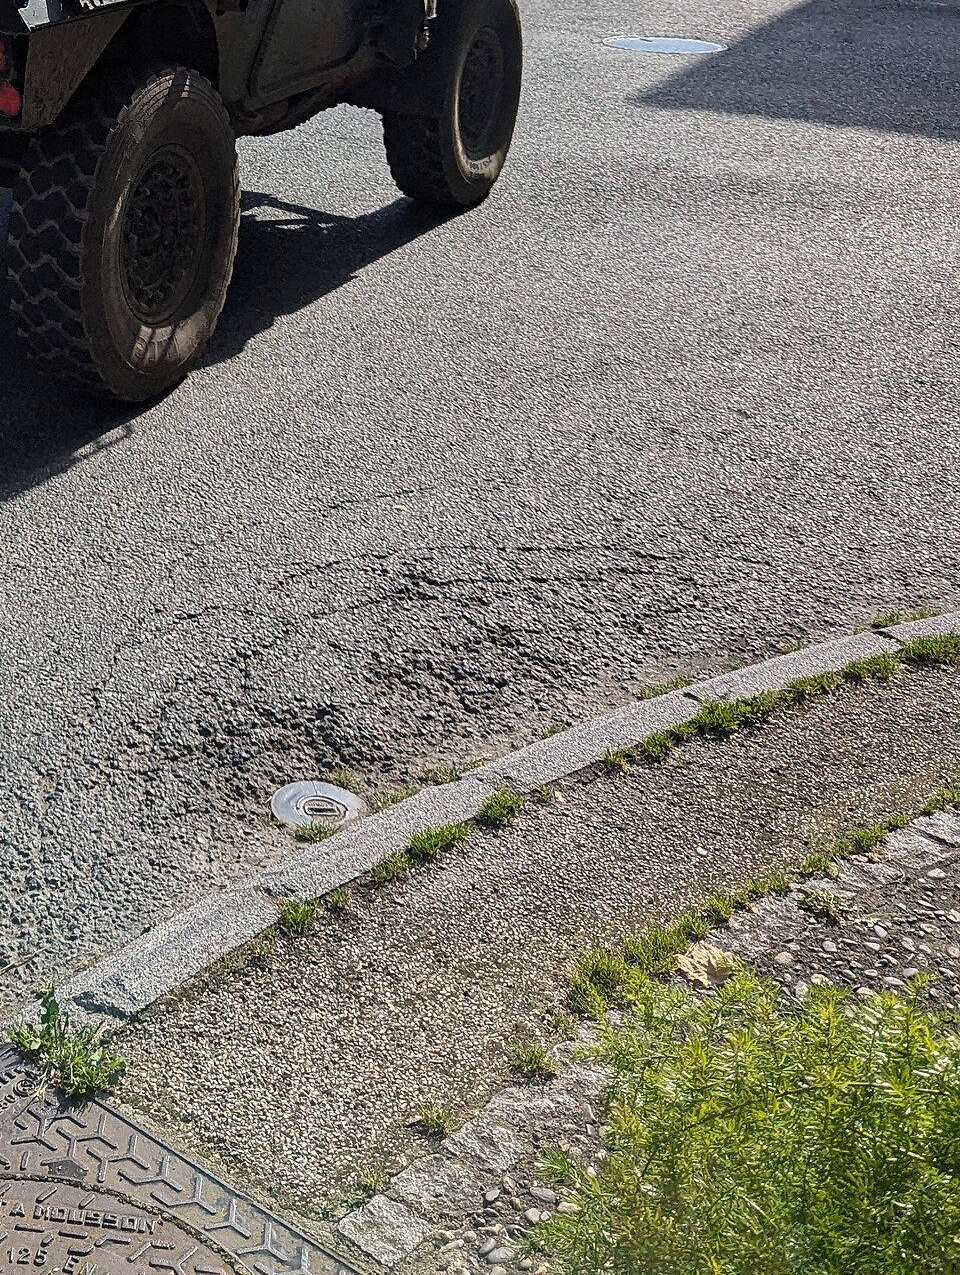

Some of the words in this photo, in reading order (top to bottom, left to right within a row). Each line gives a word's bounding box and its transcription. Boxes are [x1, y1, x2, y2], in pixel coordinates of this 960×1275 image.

[9, 1204, 25, 1218] A
[33, 1204, 158, 1234] MOUSSON
[5, 1247, 49, 1266] 125
